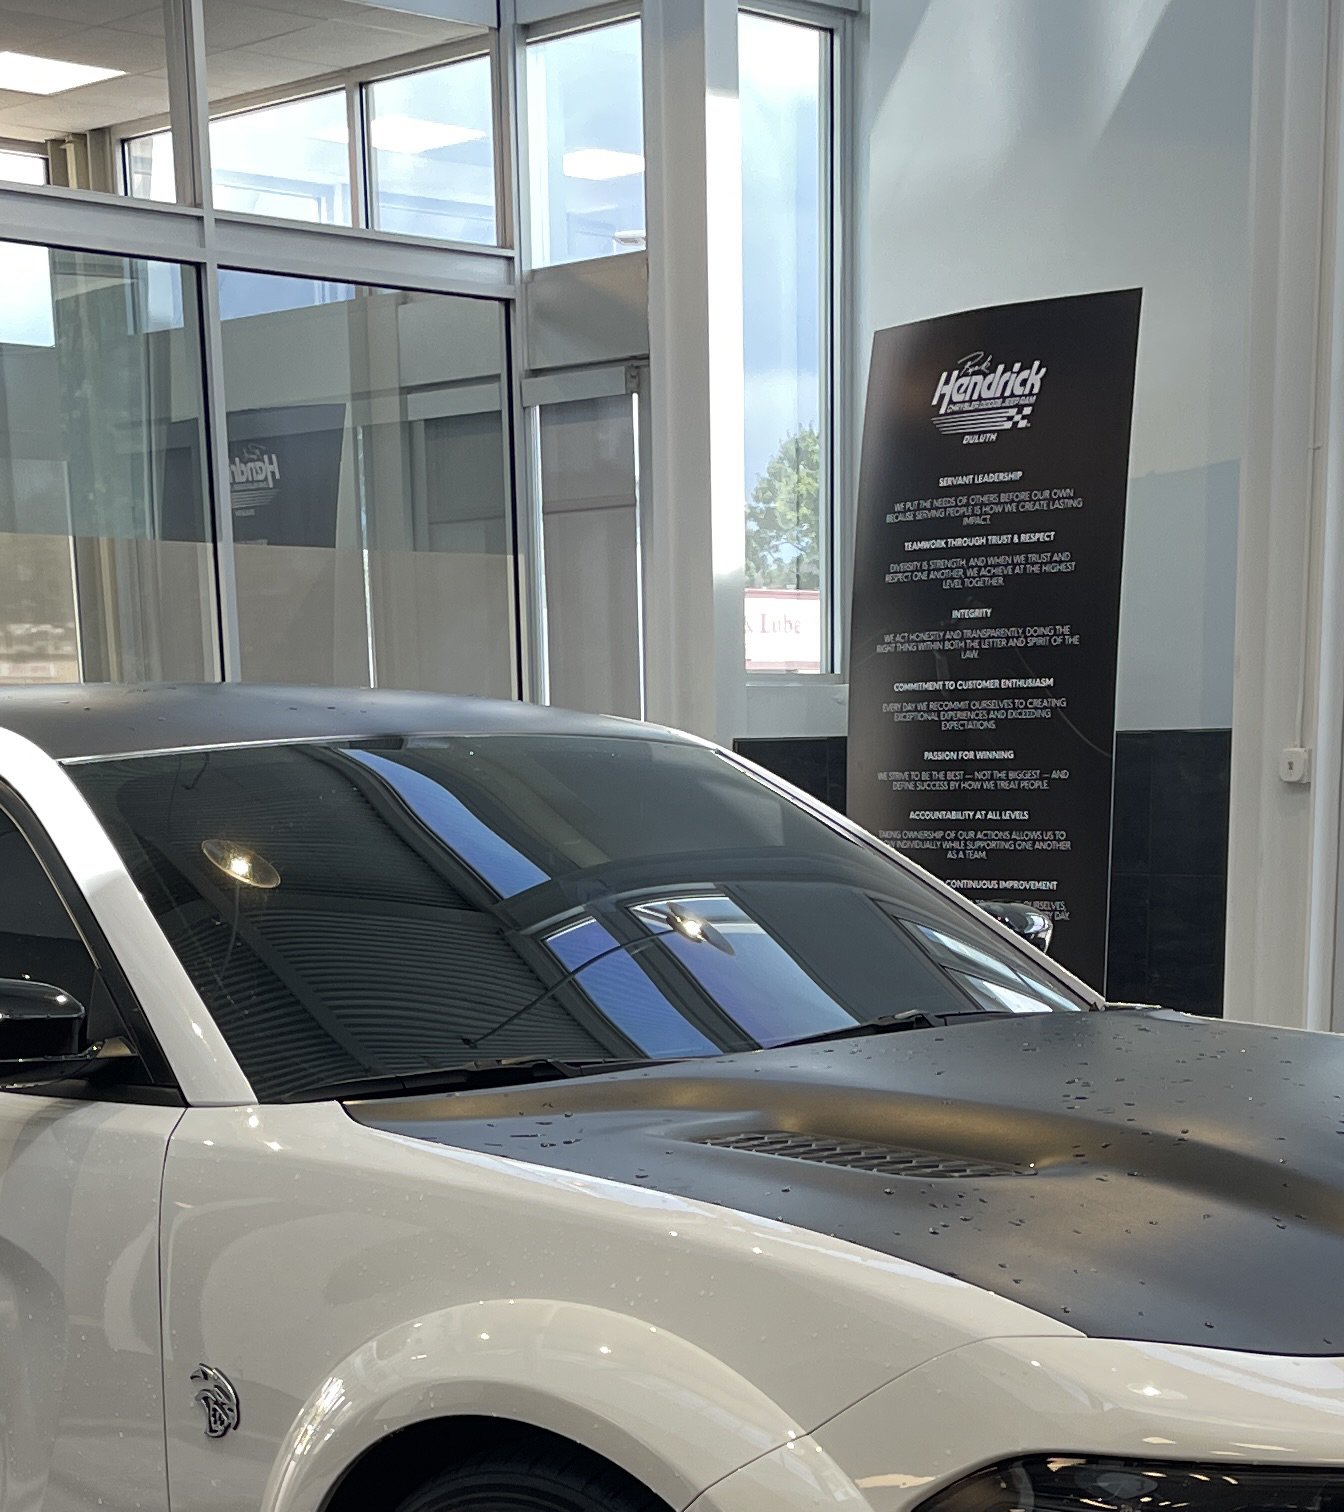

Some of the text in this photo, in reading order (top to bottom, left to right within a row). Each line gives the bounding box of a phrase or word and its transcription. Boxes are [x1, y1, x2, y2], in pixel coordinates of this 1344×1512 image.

[931, 360, 1047, 414] Hendrick
[962, 432, 998, 444] DULUTH
[939, 471, 1022, 487] SERVANT LEADERSHIP
[894, 489, 1073, 511] WE PUT THE NEEDS OF OTHERS BEFORE OUR OWN
[886, 499, 1082, 523] BECAUSE SERVING PEOPLE IS HOW WE CREATE LASTING
[905, 532, 1055, 551] TEAMWORK THROUGH TRUST & RESPECT
[890, 562, 920, 572] DIVERSITY
[922, 562, 928, 570] IS
[969, 558, 986, 567] AND
[988, 556, 1011, 566] WHEN
[1013, 555, 1026, 564] WE
[1028, 554, 1051, 563] TRUST
[1052, 552, 1071, 561] AND
[885, 573, 911, 583] RESPECT
[913, 572, 928, 581] ONE
[967, 568, 978, 578] WE
[980, 566, 1012, 577] ACHIEVE
[1015, 565, 1024, 575] AT
[1026, 564, 1040, 574] THE
[1042, 562, 1075, 573] HIGHEST
[943, 579, 962, 588] LEVEL
[952, 608, 992, 619] INTEGRITY
[884, 634, 894, 642] WE
[896, 633, 908, 642] ACT
[909, 631, 945, 641] HONESTLY
[946, 631, 961, 640] AND
[1026, 626, 1054, 636] DOING
[1056, 626, 1070, 635] THE
[877, 636, 1079, 653] RIGHT THING WITHIN BOTH THE LETTER AND SPIRIT OF THE
[894, 678, 1053, 691] COMMITMENT TO CUSTOMER ENTHUSIASM
[882, 698, 1066, 712] EVERY DAY WE RECOMMIT OURSELVES TO CREATING
[894, 709, 1051, 721] EXCEPTIONAL EXPERIENCES AND EXCEEDING
[924, 751, 1014, 760] PASSION FOR WINNING
[878, 771, 1069, 781] WE STRIVE TO BE THE BEST NOT THE BIGGEST AND
[893, 781, 915, 790] DEFINE
[917, 781, 948, 790] SUCCESS
[950, 781, 959, 790] BY
[961, 781, 981, 790] HOW
[983, 781, 995, 790] WE
[998, 781, 1019, 790] TREAT
[909, 811, 1028, 819] ACCOUNTABILITY AT ALL LEVELS
[903, 831, 944, 839] OWNERSHIP
[945, 831, 955, 839] OF
[958, 831, 974, 839] OUR
[976, 831, 1010, 839] ACTIONS
[1011, 831, 1042, 840] ALLOWS
[1044, 831, 1054, 840] US
[1055, 831, 1066, 840] TO
[897, 840, 941, 849] INDIVIDUALLY
[943, 841, 965, 849] WHILE
[967, 841, 1014, 850] SUPPORTING
[1016, 841, 1033, 850] ONE
[1034, 841, 1070, 850] ANOTHER
[947, 850, 957, 859] AS
[959, 851, 964, 859] A
[946, 880, 1057, 890] CONTINUOUS IMPROVEMENT
